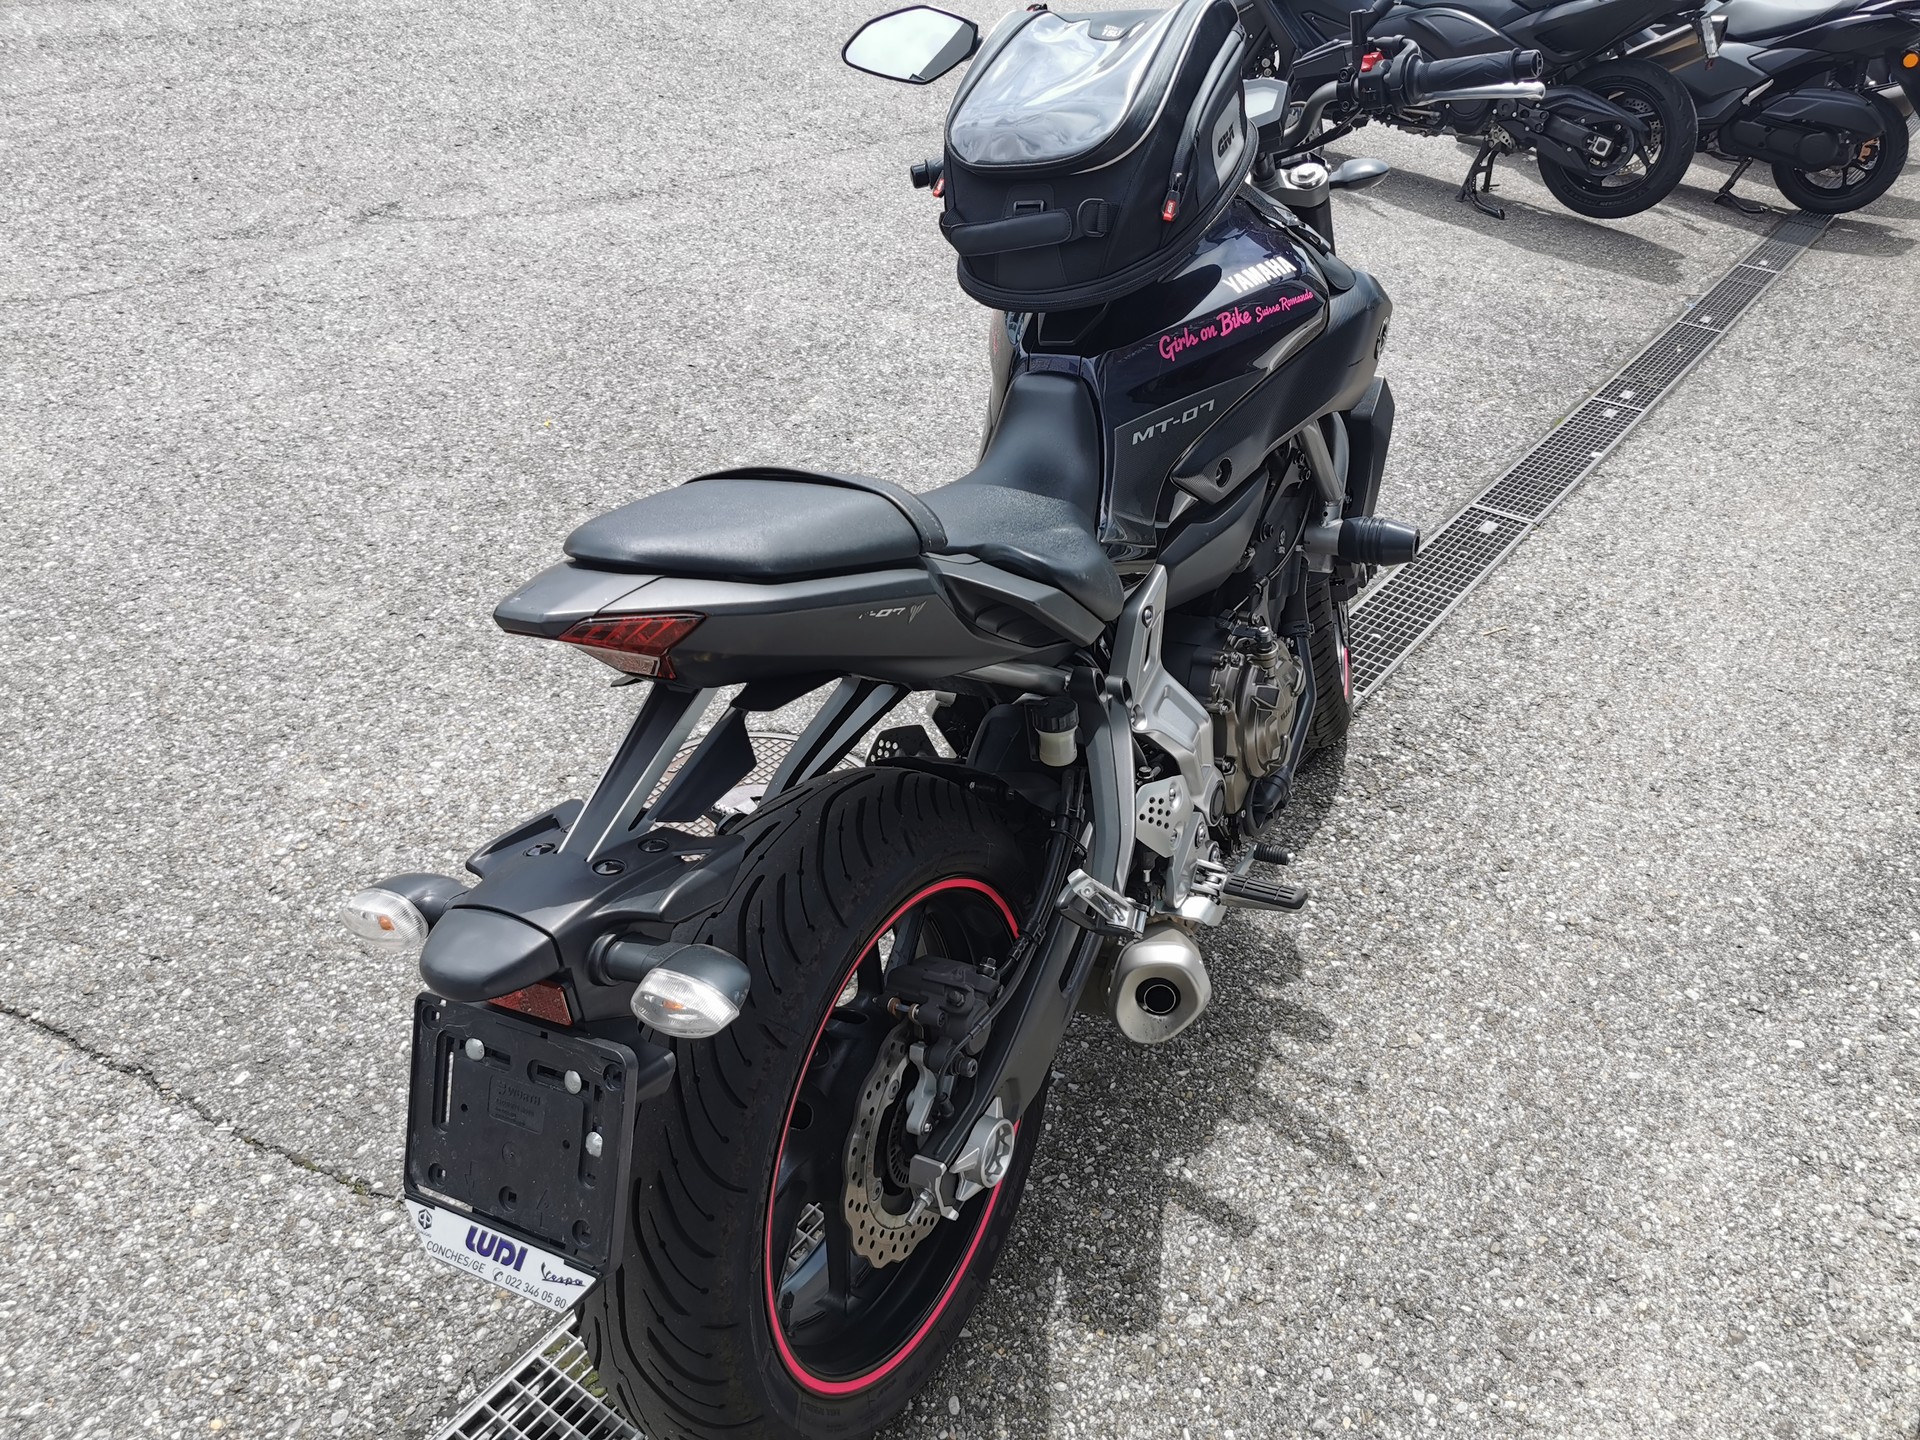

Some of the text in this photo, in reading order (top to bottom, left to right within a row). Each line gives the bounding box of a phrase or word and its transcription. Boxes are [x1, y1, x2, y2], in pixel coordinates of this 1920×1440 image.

[1217, 121, 1235, 158] GIVI
[1222, 256, 1297, 294] YAMAHA
[1158, 288, 1314, 362] Girls on Bike Suisse Romande
[1131, 398, 1216, 446] MT-07
[426, 1240, 485, 1274] CONCHES/GE
[465, 1225, 529, 1272] LUDI
[505, 1274, 567, 1309] 022 346 05 80
[540, 1261, 586, 1287] Vespa
